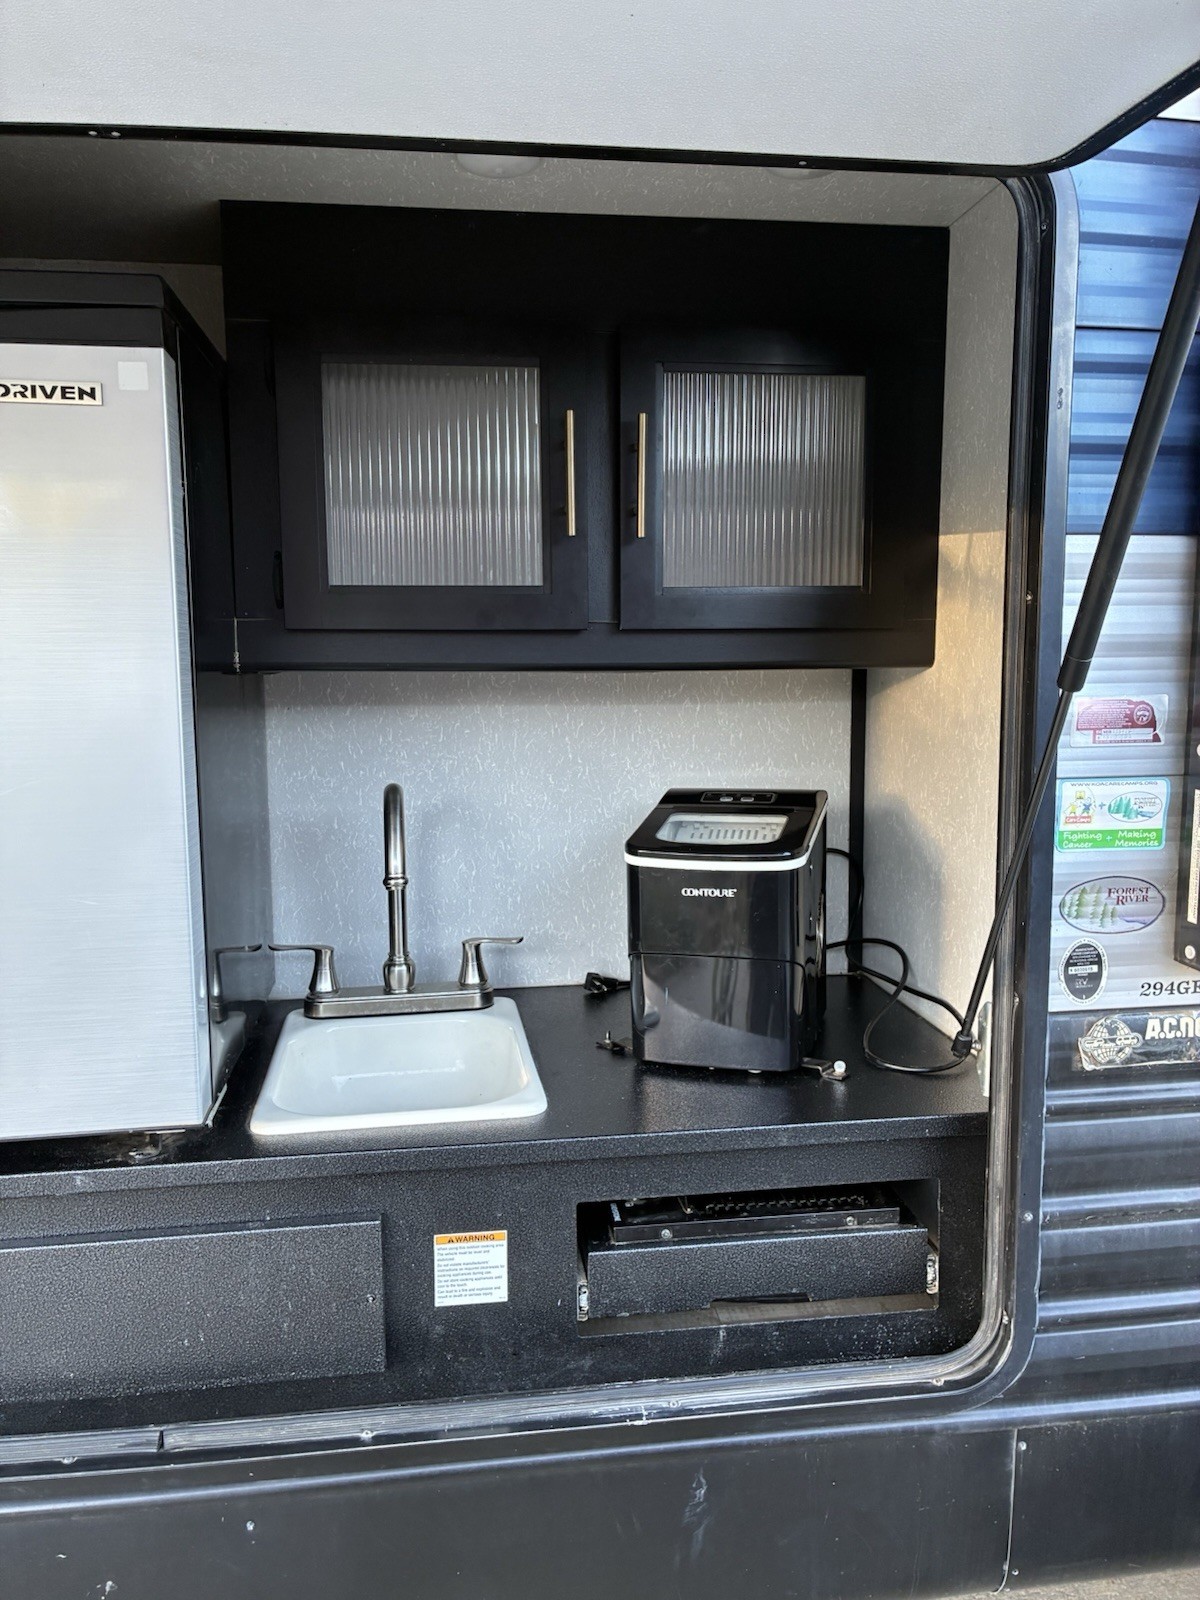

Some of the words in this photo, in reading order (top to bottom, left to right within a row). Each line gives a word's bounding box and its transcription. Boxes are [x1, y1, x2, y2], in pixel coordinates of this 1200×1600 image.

[1063, 831, 1102, 841] Fighting
[1118, 830, 1157, 838] Making
[1063, 840, 1093, 848] Cancer
[1114, 839, 1159, 848] Memories
[1107, 886, 1151, 898] FOREST
[1116, 895, 1149, 906] RIVER
[455, 1234, 495, 1243] WARNING
